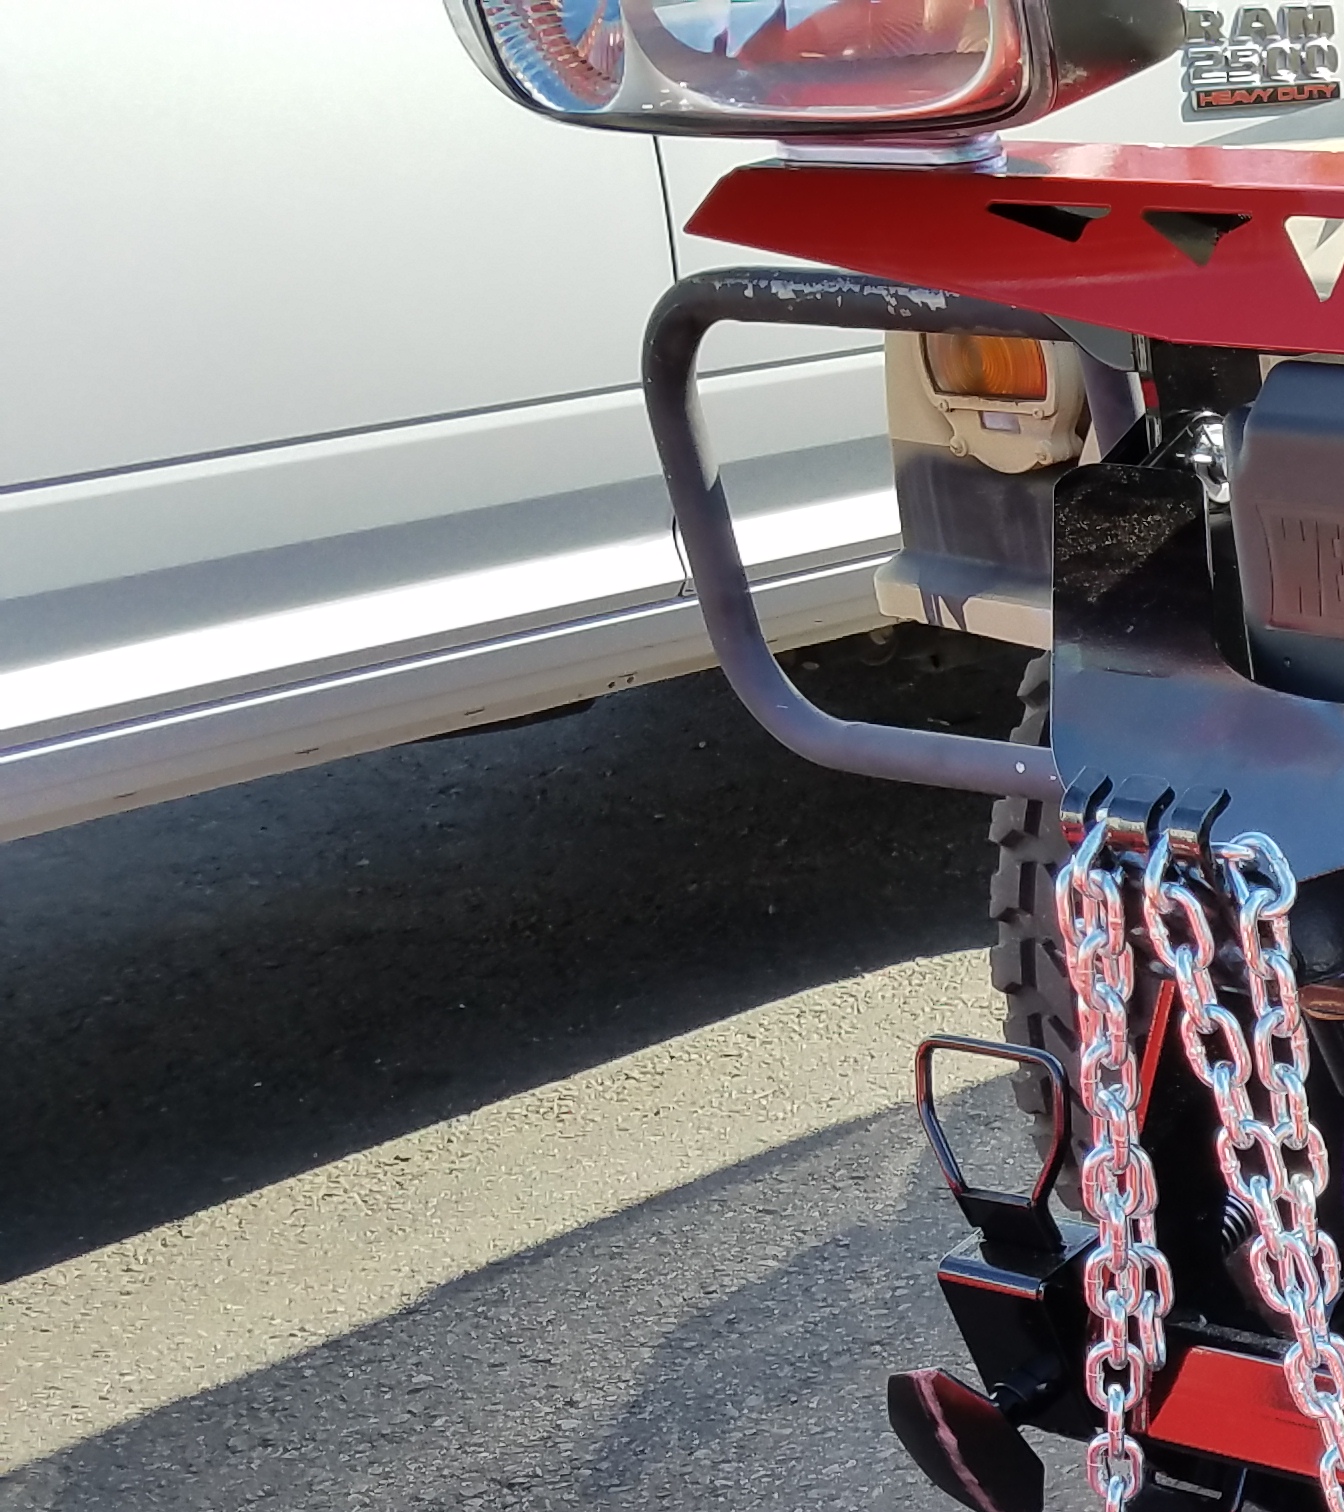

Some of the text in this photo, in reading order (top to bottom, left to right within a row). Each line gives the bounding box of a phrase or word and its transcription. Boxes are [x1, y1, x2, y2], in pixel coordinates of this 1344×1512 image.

[1185, 5, 1335, 43] RAM
[1187, 44, 1340, 85] 2500
[1200, 83, 1337, 107] HEAVY DUTY
